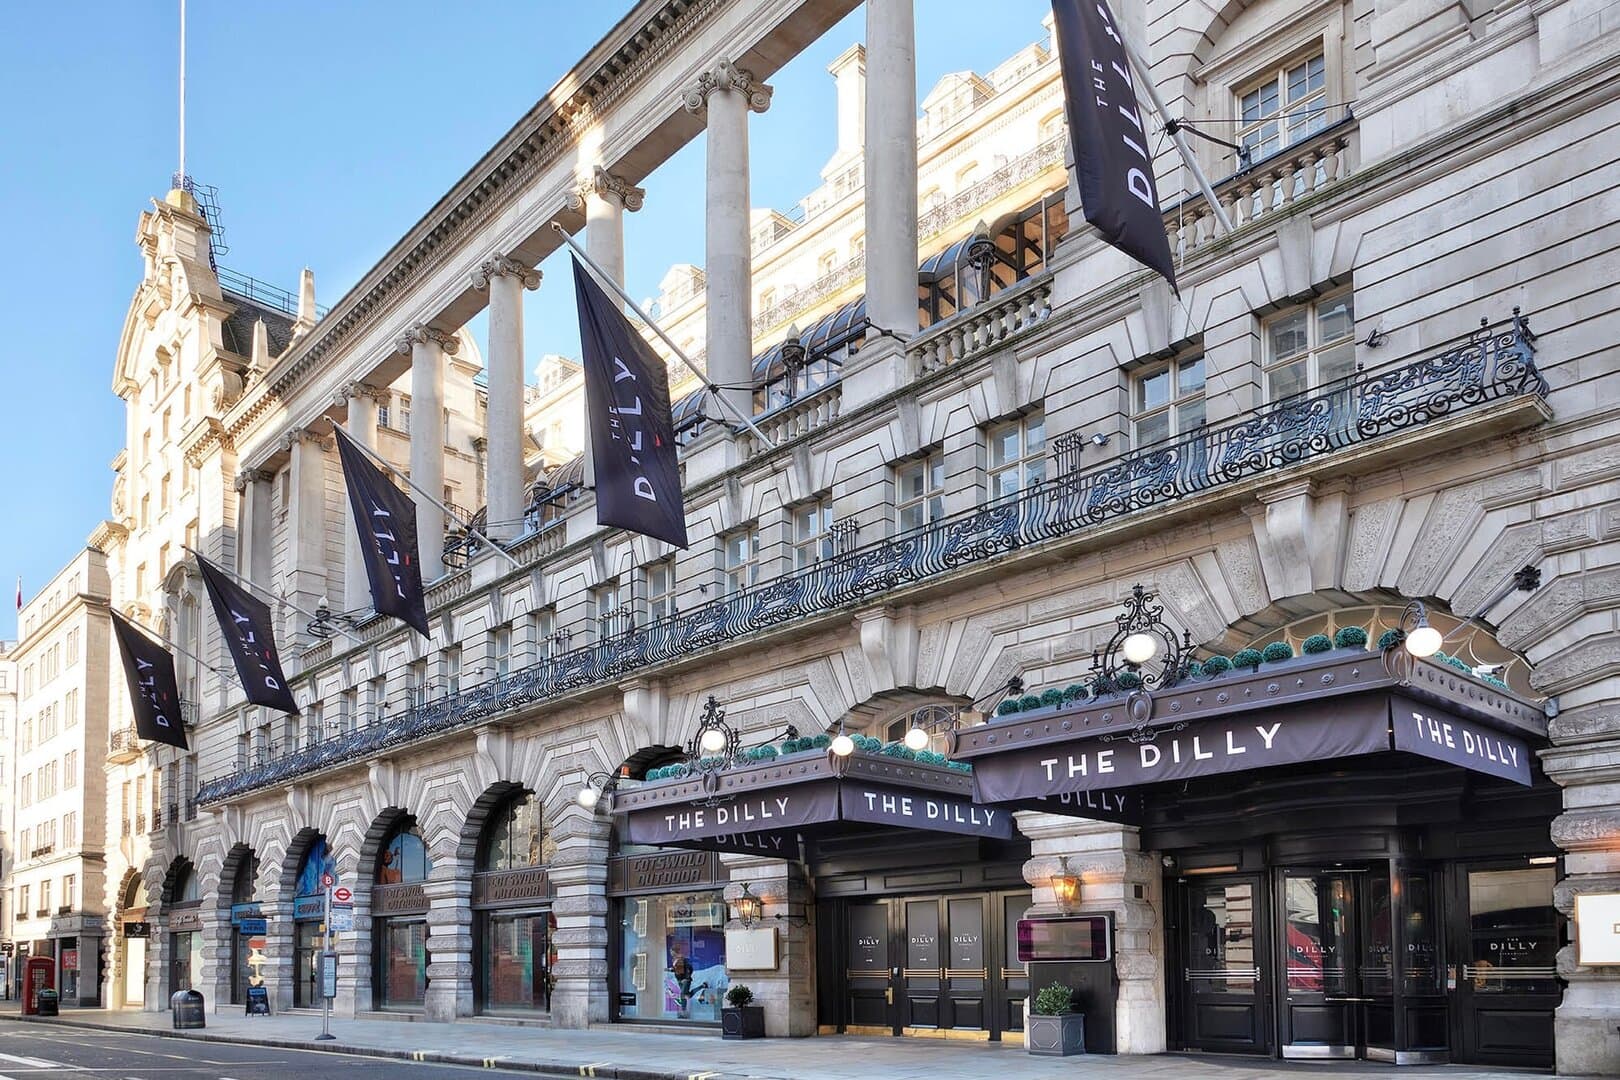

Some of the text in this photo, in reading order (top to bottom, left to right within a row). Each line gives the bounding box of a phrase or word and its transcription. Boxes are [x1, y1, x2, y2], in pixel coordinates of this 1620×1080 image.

[1091, 59, 1107, 107] THE
[609, 406, 621, 440] THE
[231, 609, 280, 690] DILY
[1041, 722, 1282, 781] THE DILLY
[1411, 712, 1517, 768] THE DILLY
[664, 797, 789, 831] THE DILLY
[864, 792, 995, 826] THE DILLY
[634, 852, 706, 872] COTSWOLD
[325, 876, 332, 885] B
[911, 936, 934, 944] DILLY
[954, 935, 978, 943] DILLY
[1296, 945, 1336, 953] DILLY
[1490, 942, 1537, 951] DILLY
